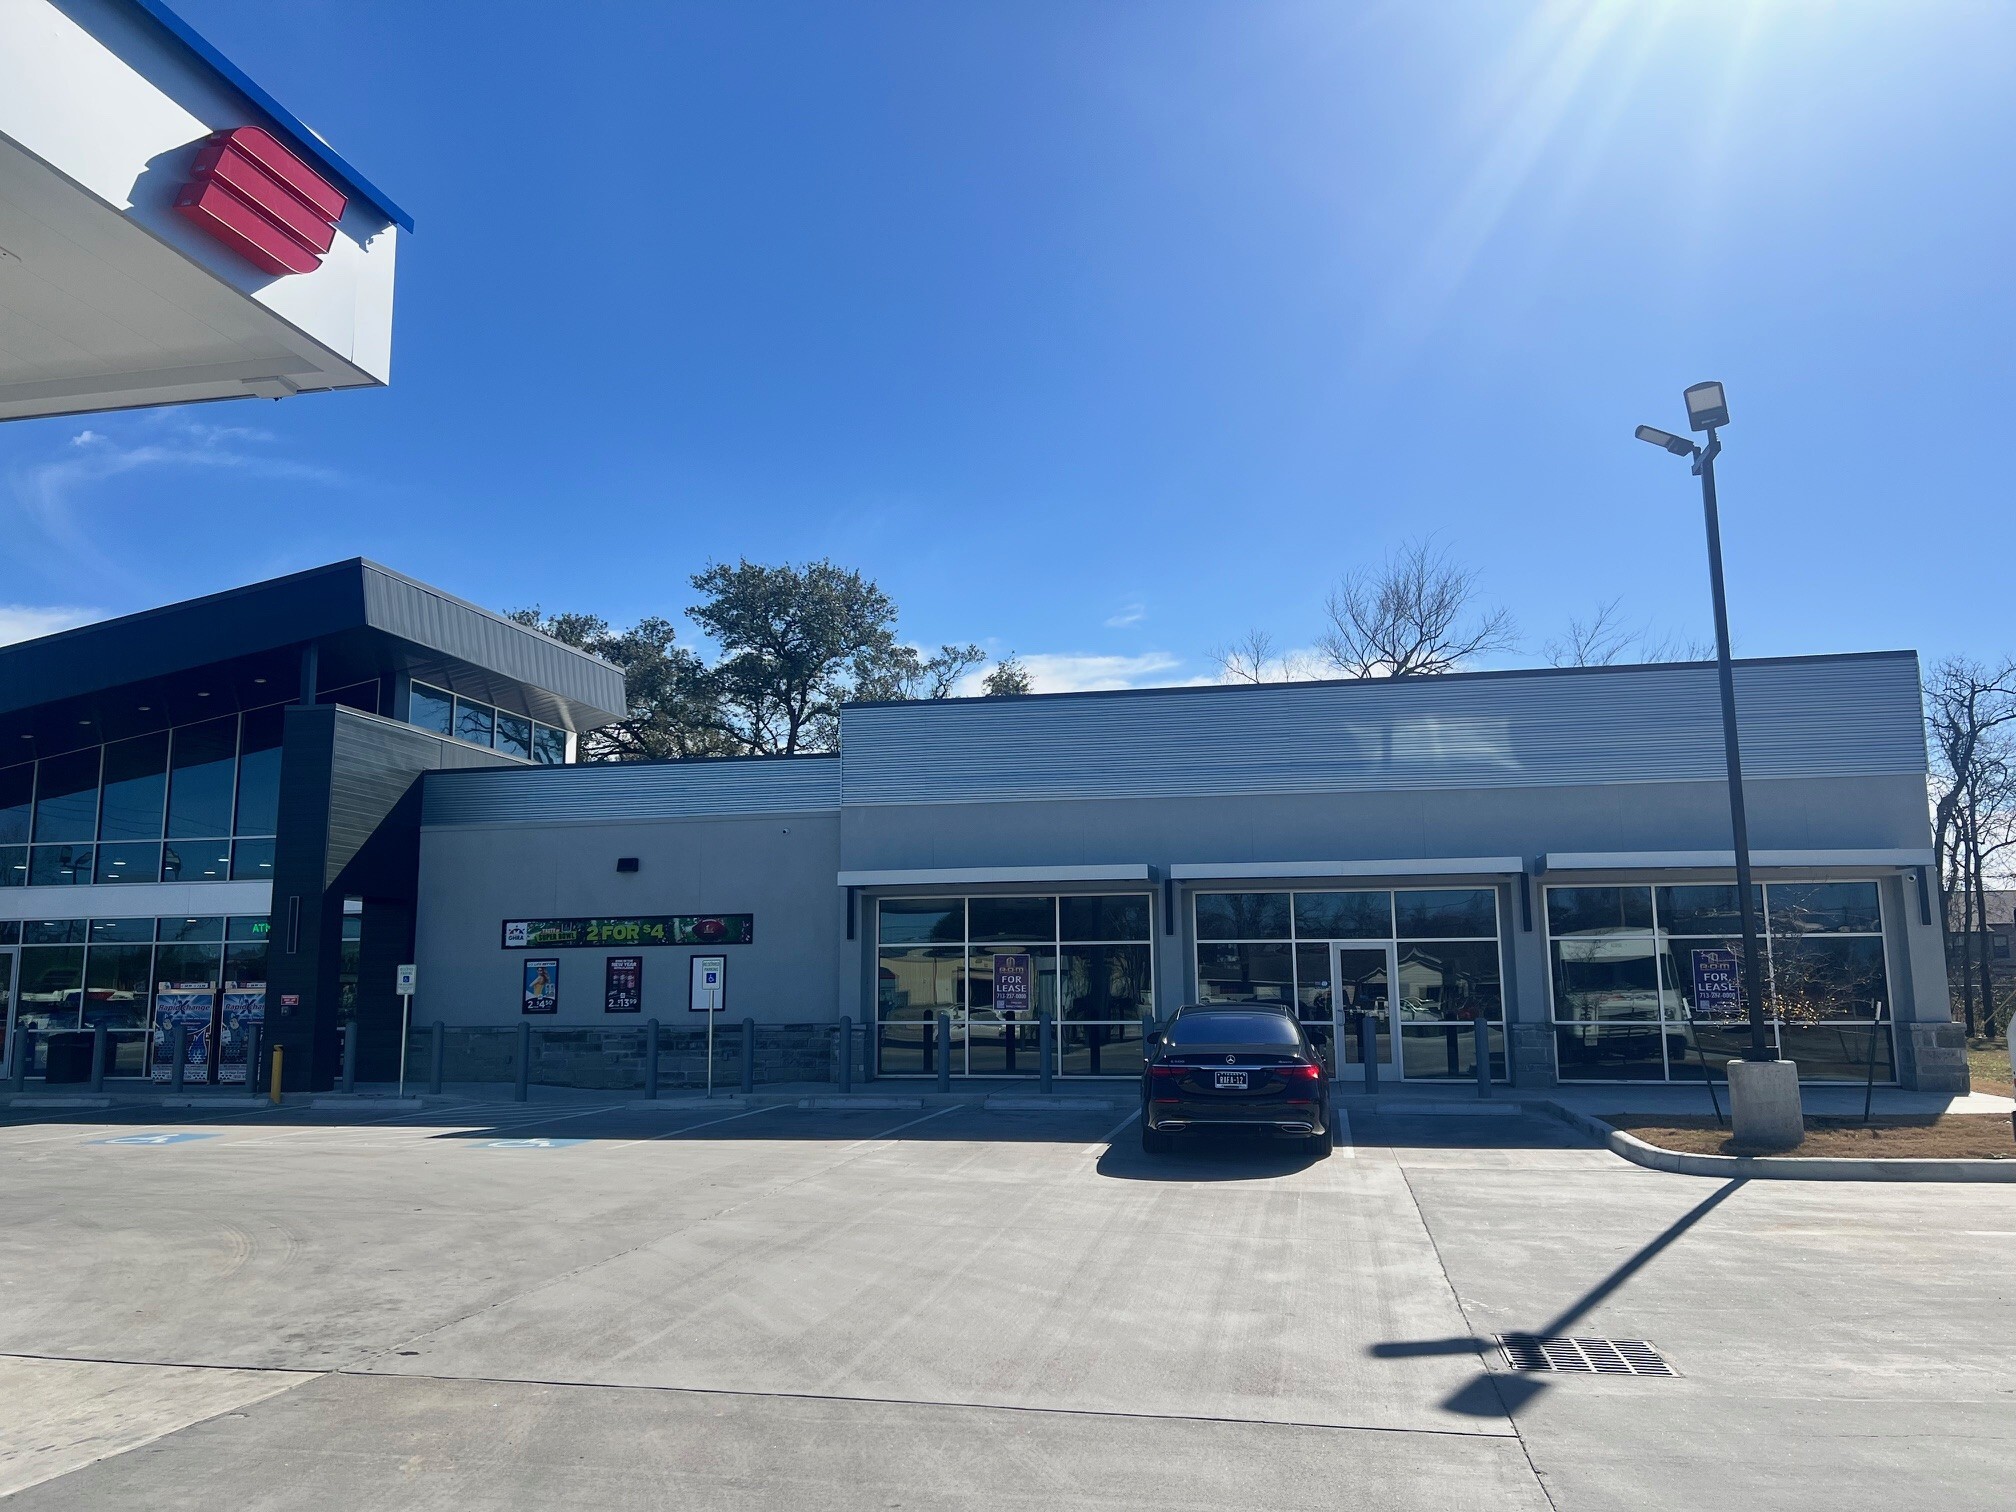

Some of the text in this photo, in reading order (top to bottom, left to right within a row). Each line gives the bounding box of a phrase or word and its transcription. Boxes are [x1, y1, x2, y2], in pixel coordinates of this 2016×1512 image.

[586, 923, 665, 940] 2 FOR $4
[538, 932, 576, 941] SUPER BOWL
[1703, 973, 1728, 981] FOR
[1698, 982, 1736, 991] LEASE
[527, 1000, 534, 1009] 2
[608, 998, 615, 1007] 2
